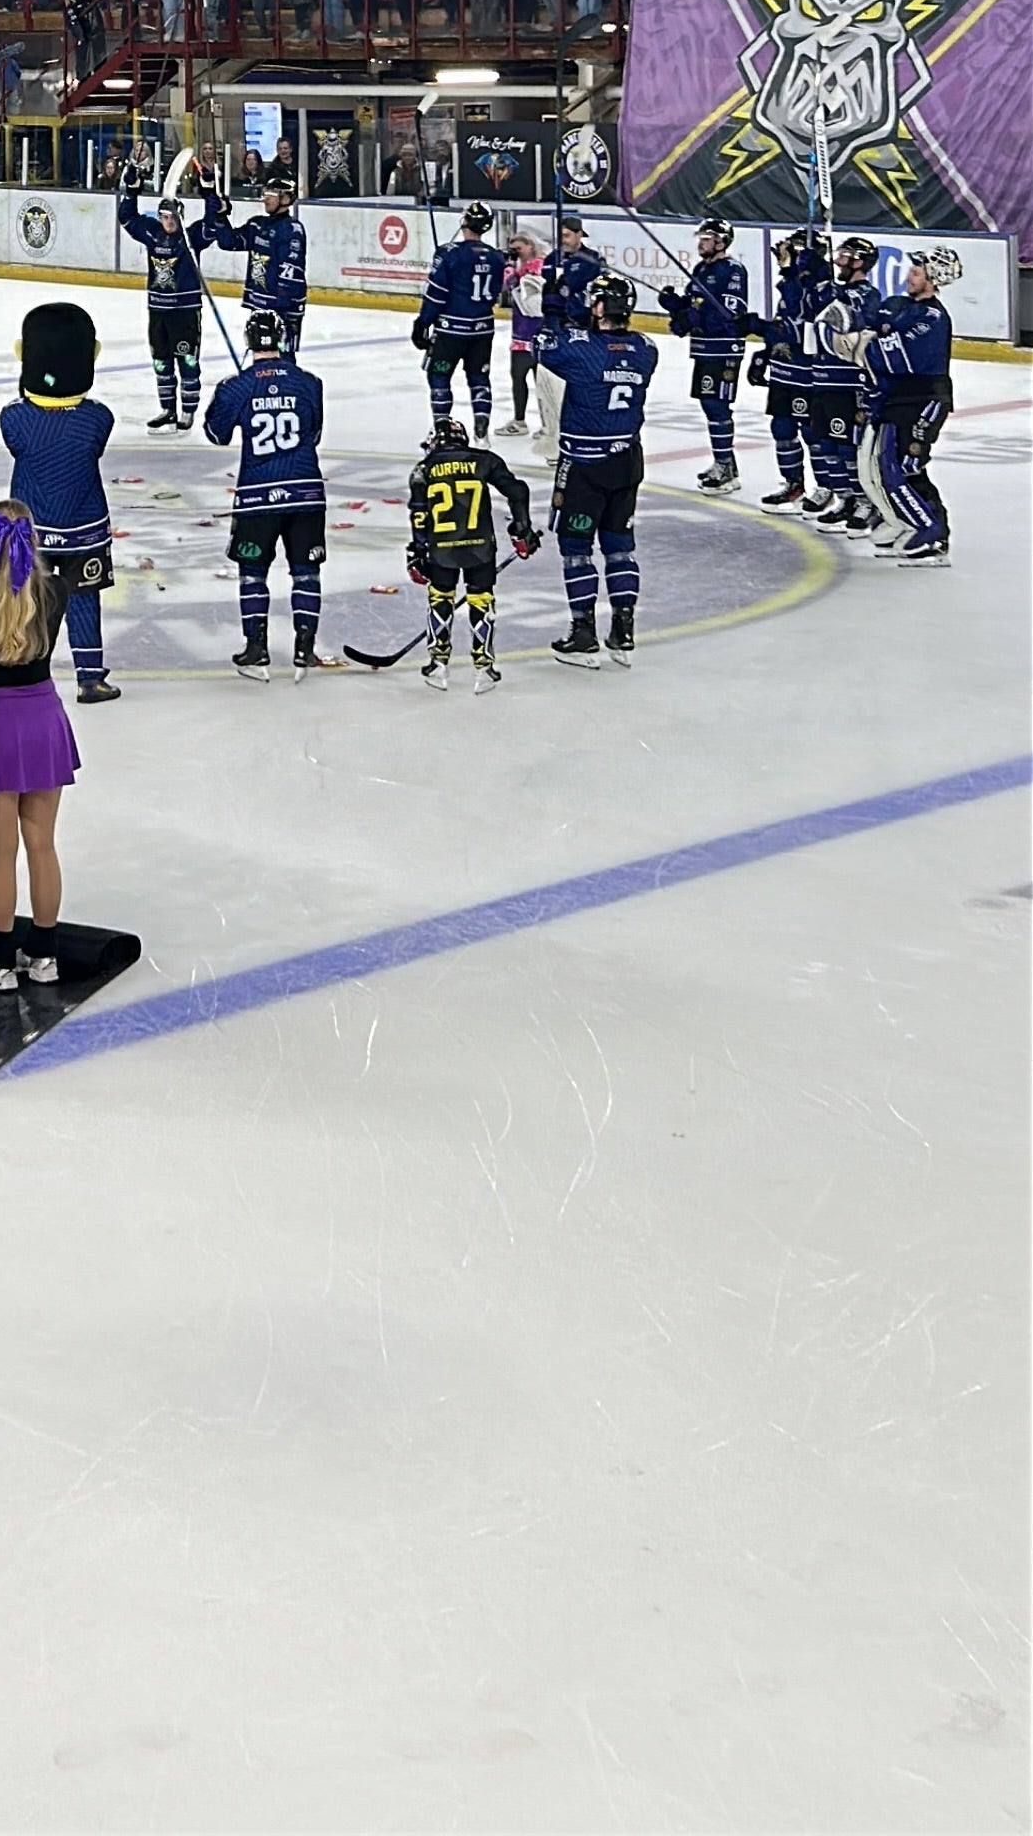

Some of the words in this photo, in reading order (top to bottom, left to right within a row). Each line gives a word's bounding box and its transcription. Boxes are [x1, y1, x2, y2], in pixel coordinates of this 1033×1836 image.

[252, 396, 296, 411] CRAWLEY
[250, 412, 301, 455] 20
[430, 461, 477, 478] MURPHY
[427, 480, 483, 533] 27
